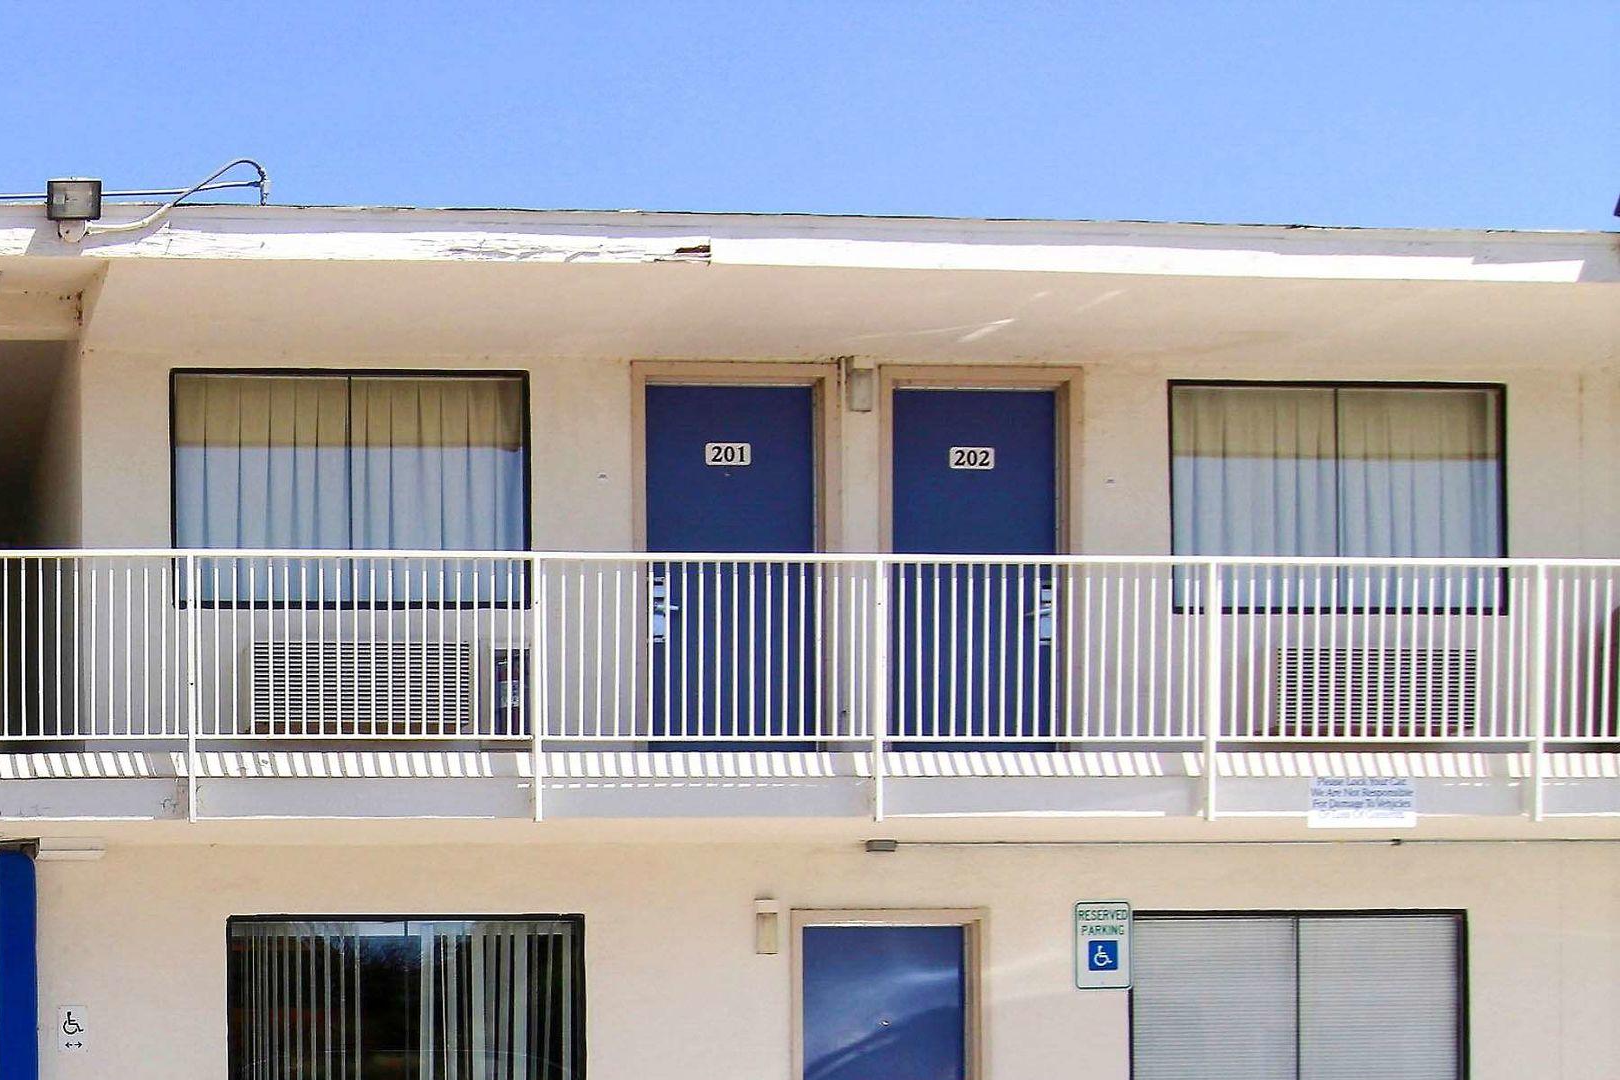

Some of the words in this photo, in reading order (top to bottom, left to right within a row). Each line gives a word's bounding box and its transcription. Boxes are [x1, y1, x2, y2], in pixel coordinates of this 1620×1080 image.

[711, 445, 746, 463] 201
[954, 449, 991, 467] 202
[1078, 909, 1128, 921] RESERVED
[1081, 924, 1125, 935] PARKING
